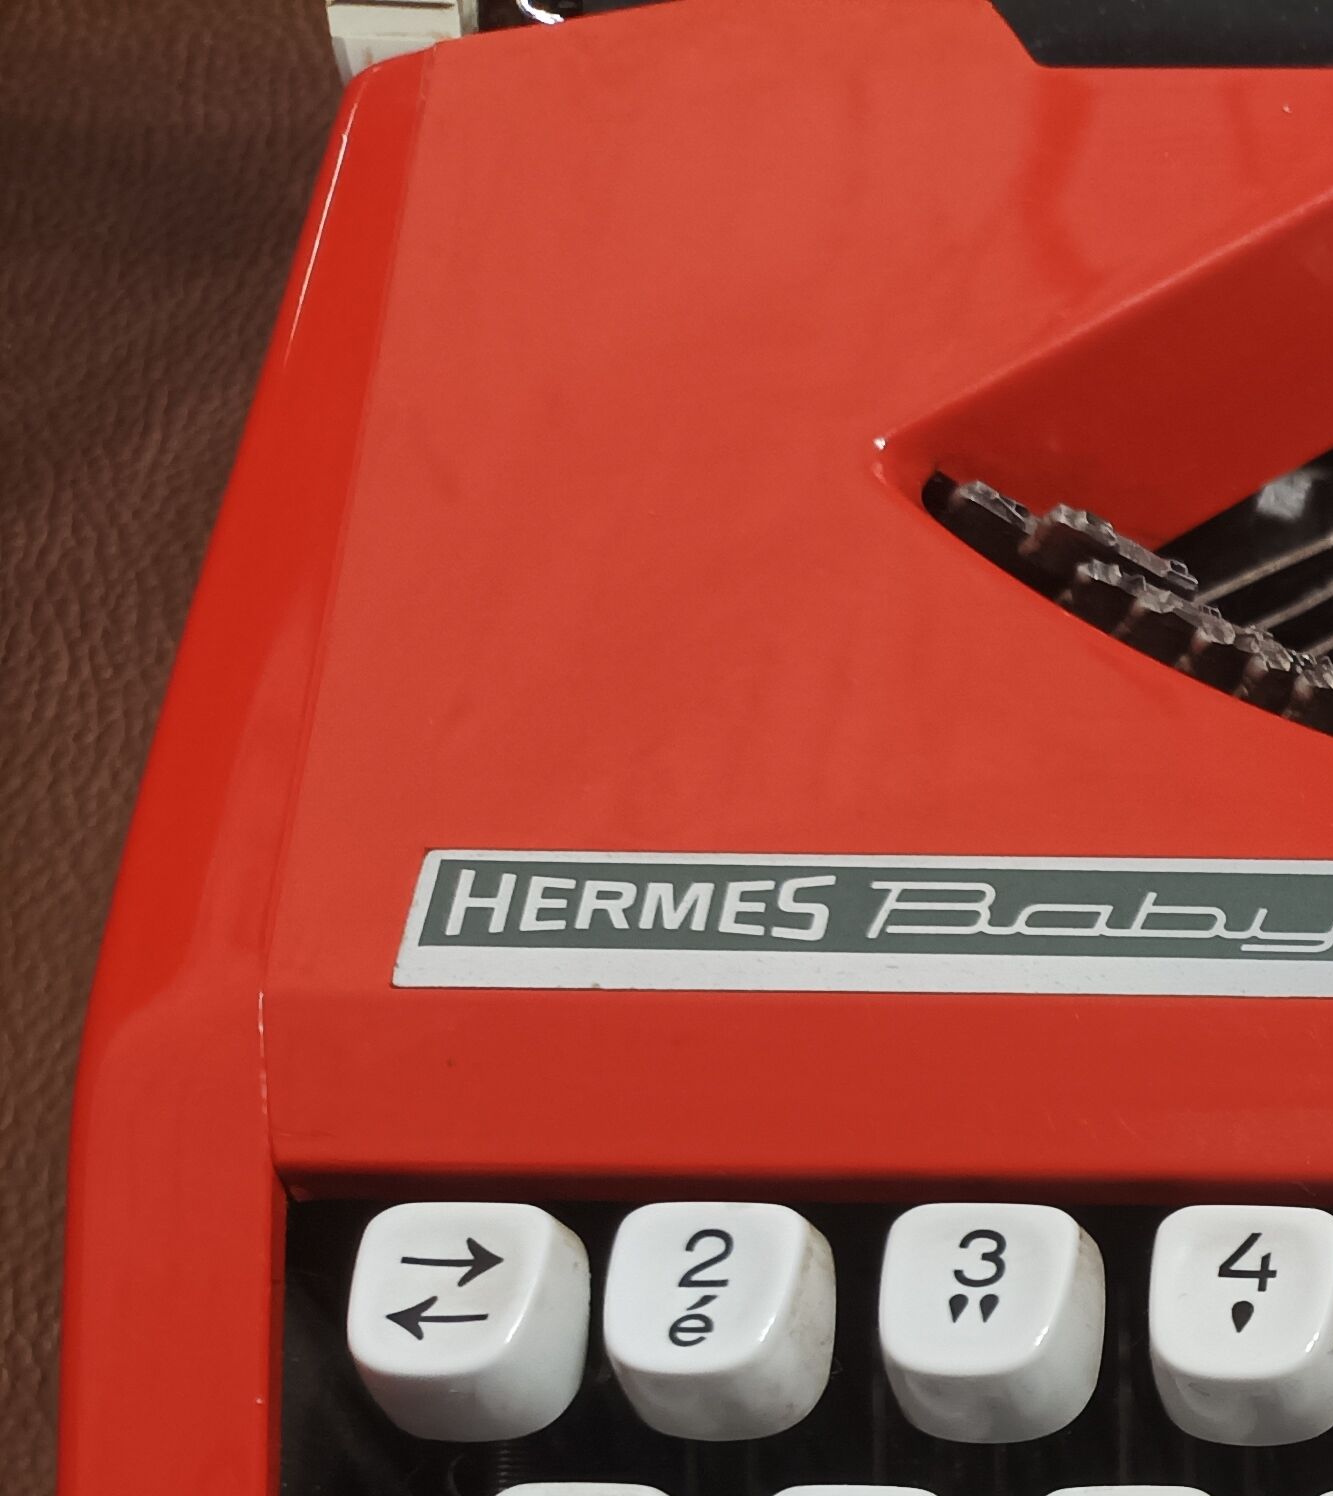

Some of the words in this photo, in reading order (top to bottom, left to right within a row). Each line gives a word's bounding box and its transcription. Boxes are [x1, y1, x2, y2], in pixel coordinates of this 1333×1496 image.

[445, 869, 837, 942] HERMES
[678, 1229, 733, 1287] 2
[954, 1230, 1006, 1287] 3
[1218, 1233, 1277, 1292] 4
[669, 1295, 717, 1347] é
